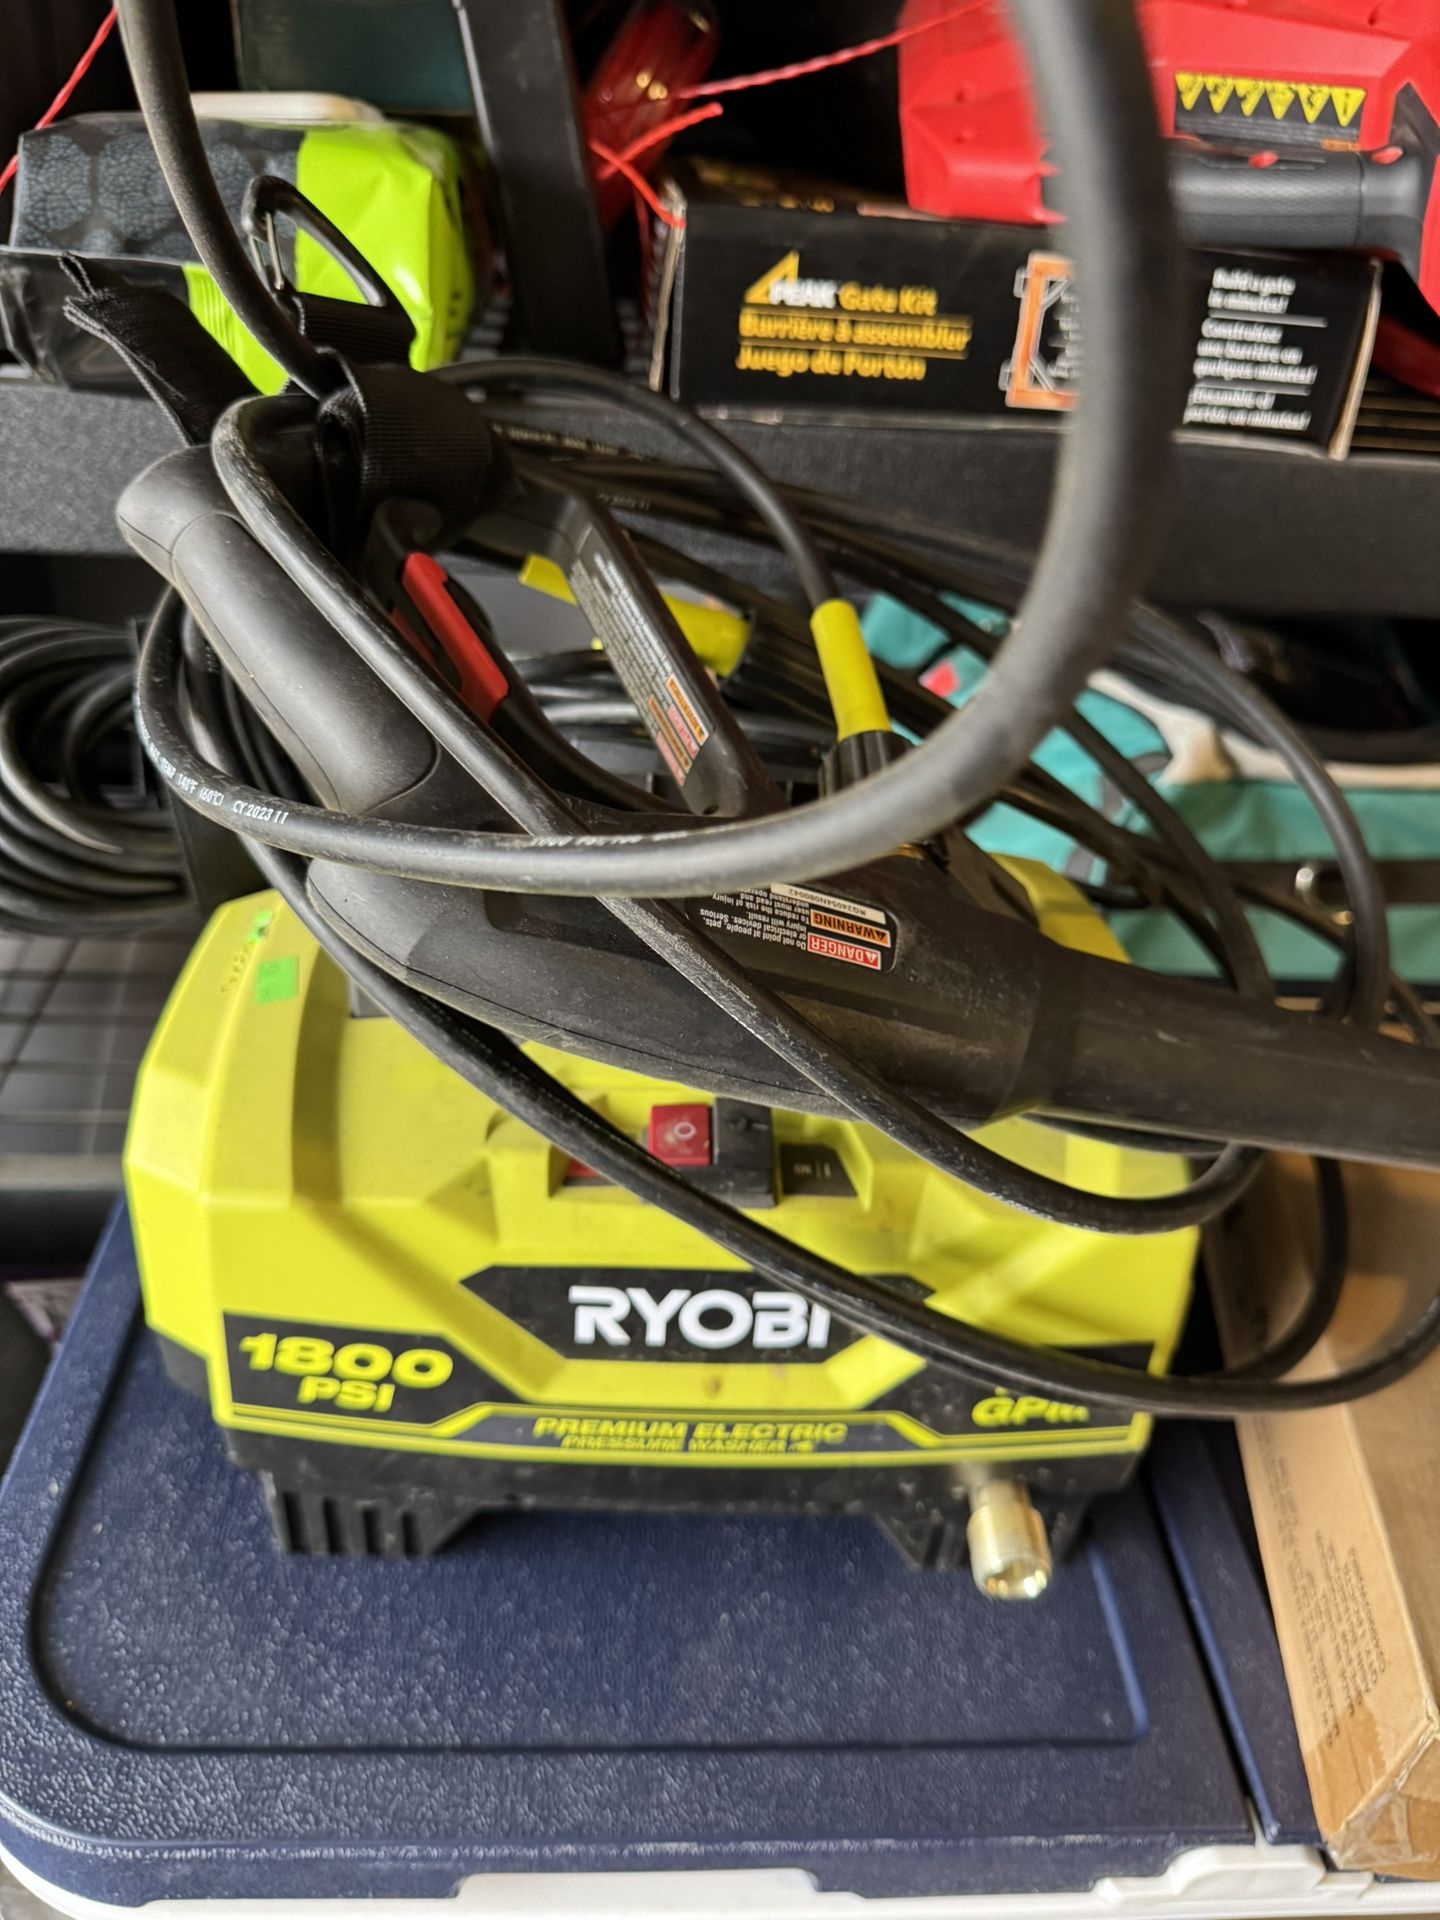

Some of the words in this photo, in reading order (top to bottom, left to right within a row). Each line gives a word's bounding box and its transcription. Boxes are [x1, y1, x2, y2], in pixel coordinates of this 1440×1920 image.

[735, 899, 744, 907] of
[740, 892, 755, 901] and
[745, 901, 759, 911] risk
[760, 906, 773, 915] the
[700, 908, 729, 923] Serious
[763, 923, 798, 938] electrical
[814, 912, 876, 940] WARNING
[753, 930, 761, 938] at
[762, 932, 782, 942] point
[783, 937, 795, 946] not
[796, 941, 807, 951] Do
[811, 936, 864, 962] DANGER
[568, 1284, 831, 1350] RYOBI
[239, 1331, 454, 1390] 1800
[297, 1375, 397, 1413] PSI
[532, 1416, 690, 1441] PREMIUM
[692, 1421, 849, 1443] ELECTRIC
[560, 1434, 685, 1452] PRESSURE
